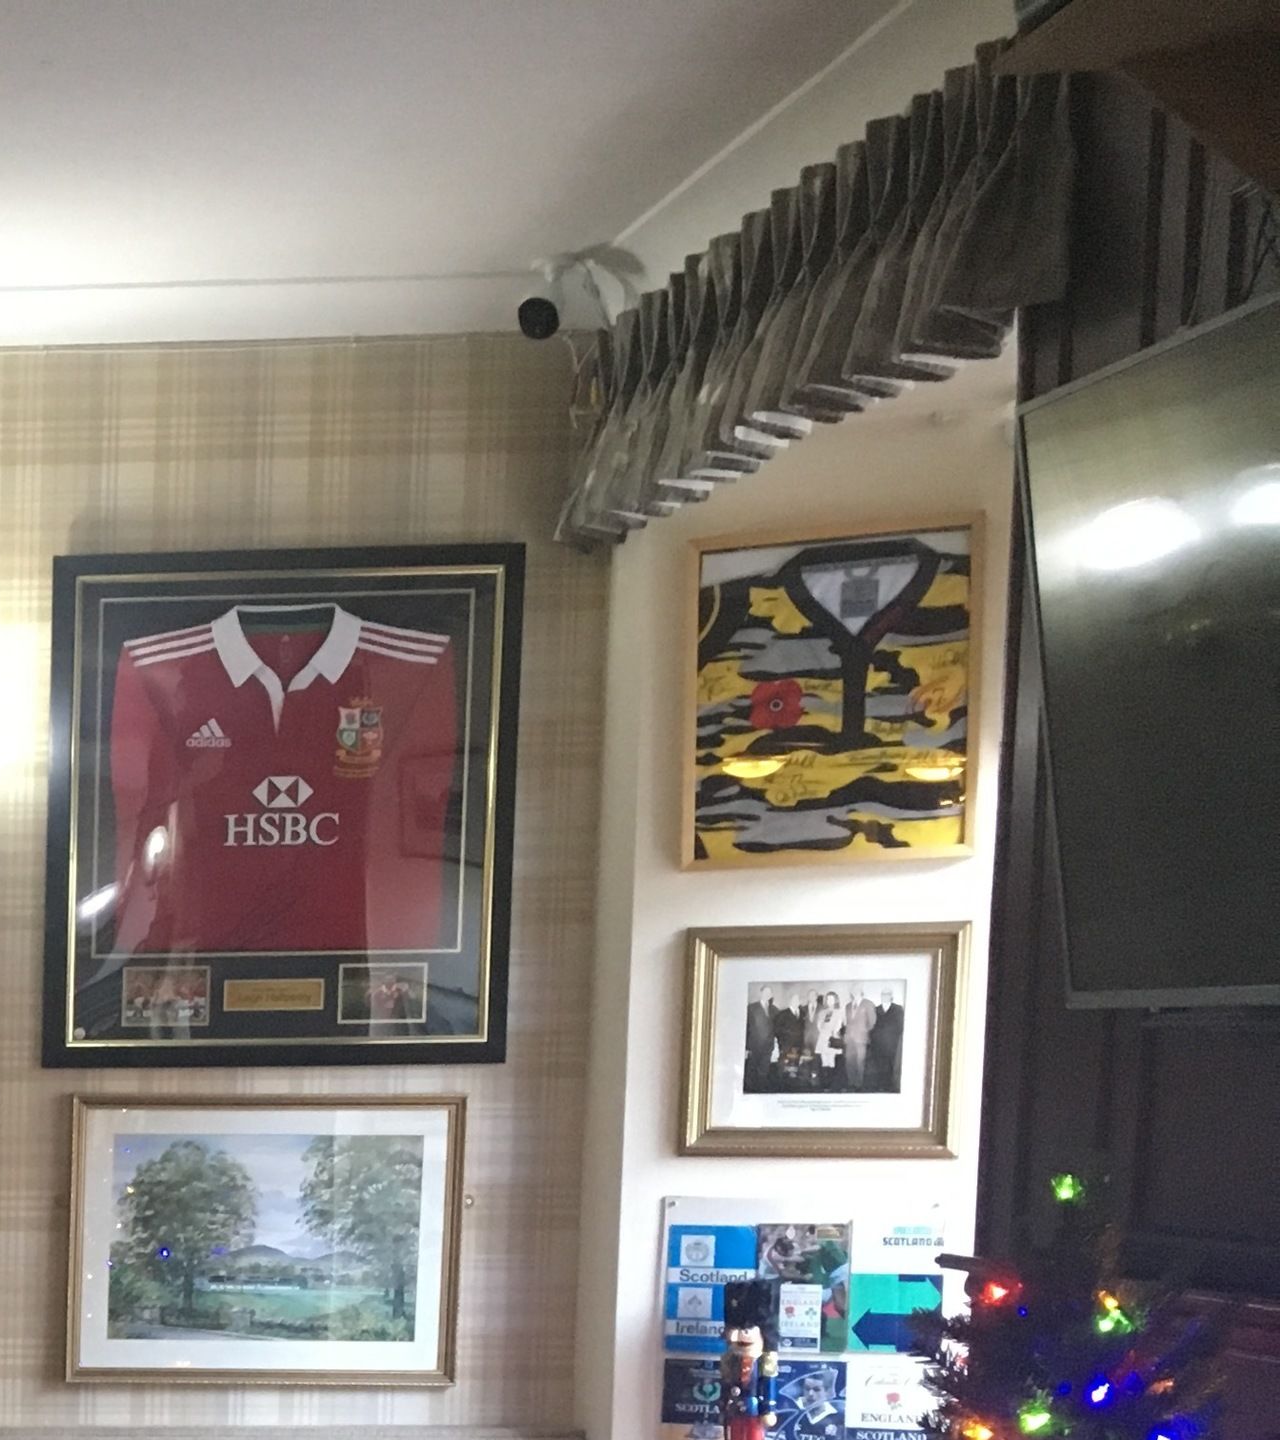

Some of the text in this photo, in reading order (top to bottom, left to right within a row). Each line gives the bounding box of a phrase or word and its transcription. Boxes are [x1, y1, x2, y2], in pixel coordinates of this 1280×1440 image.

[185, 736, 233, 748] adidas
[223, 812, 341, 847] HSBC
[679, 1268, 748, 1283] Scotland
